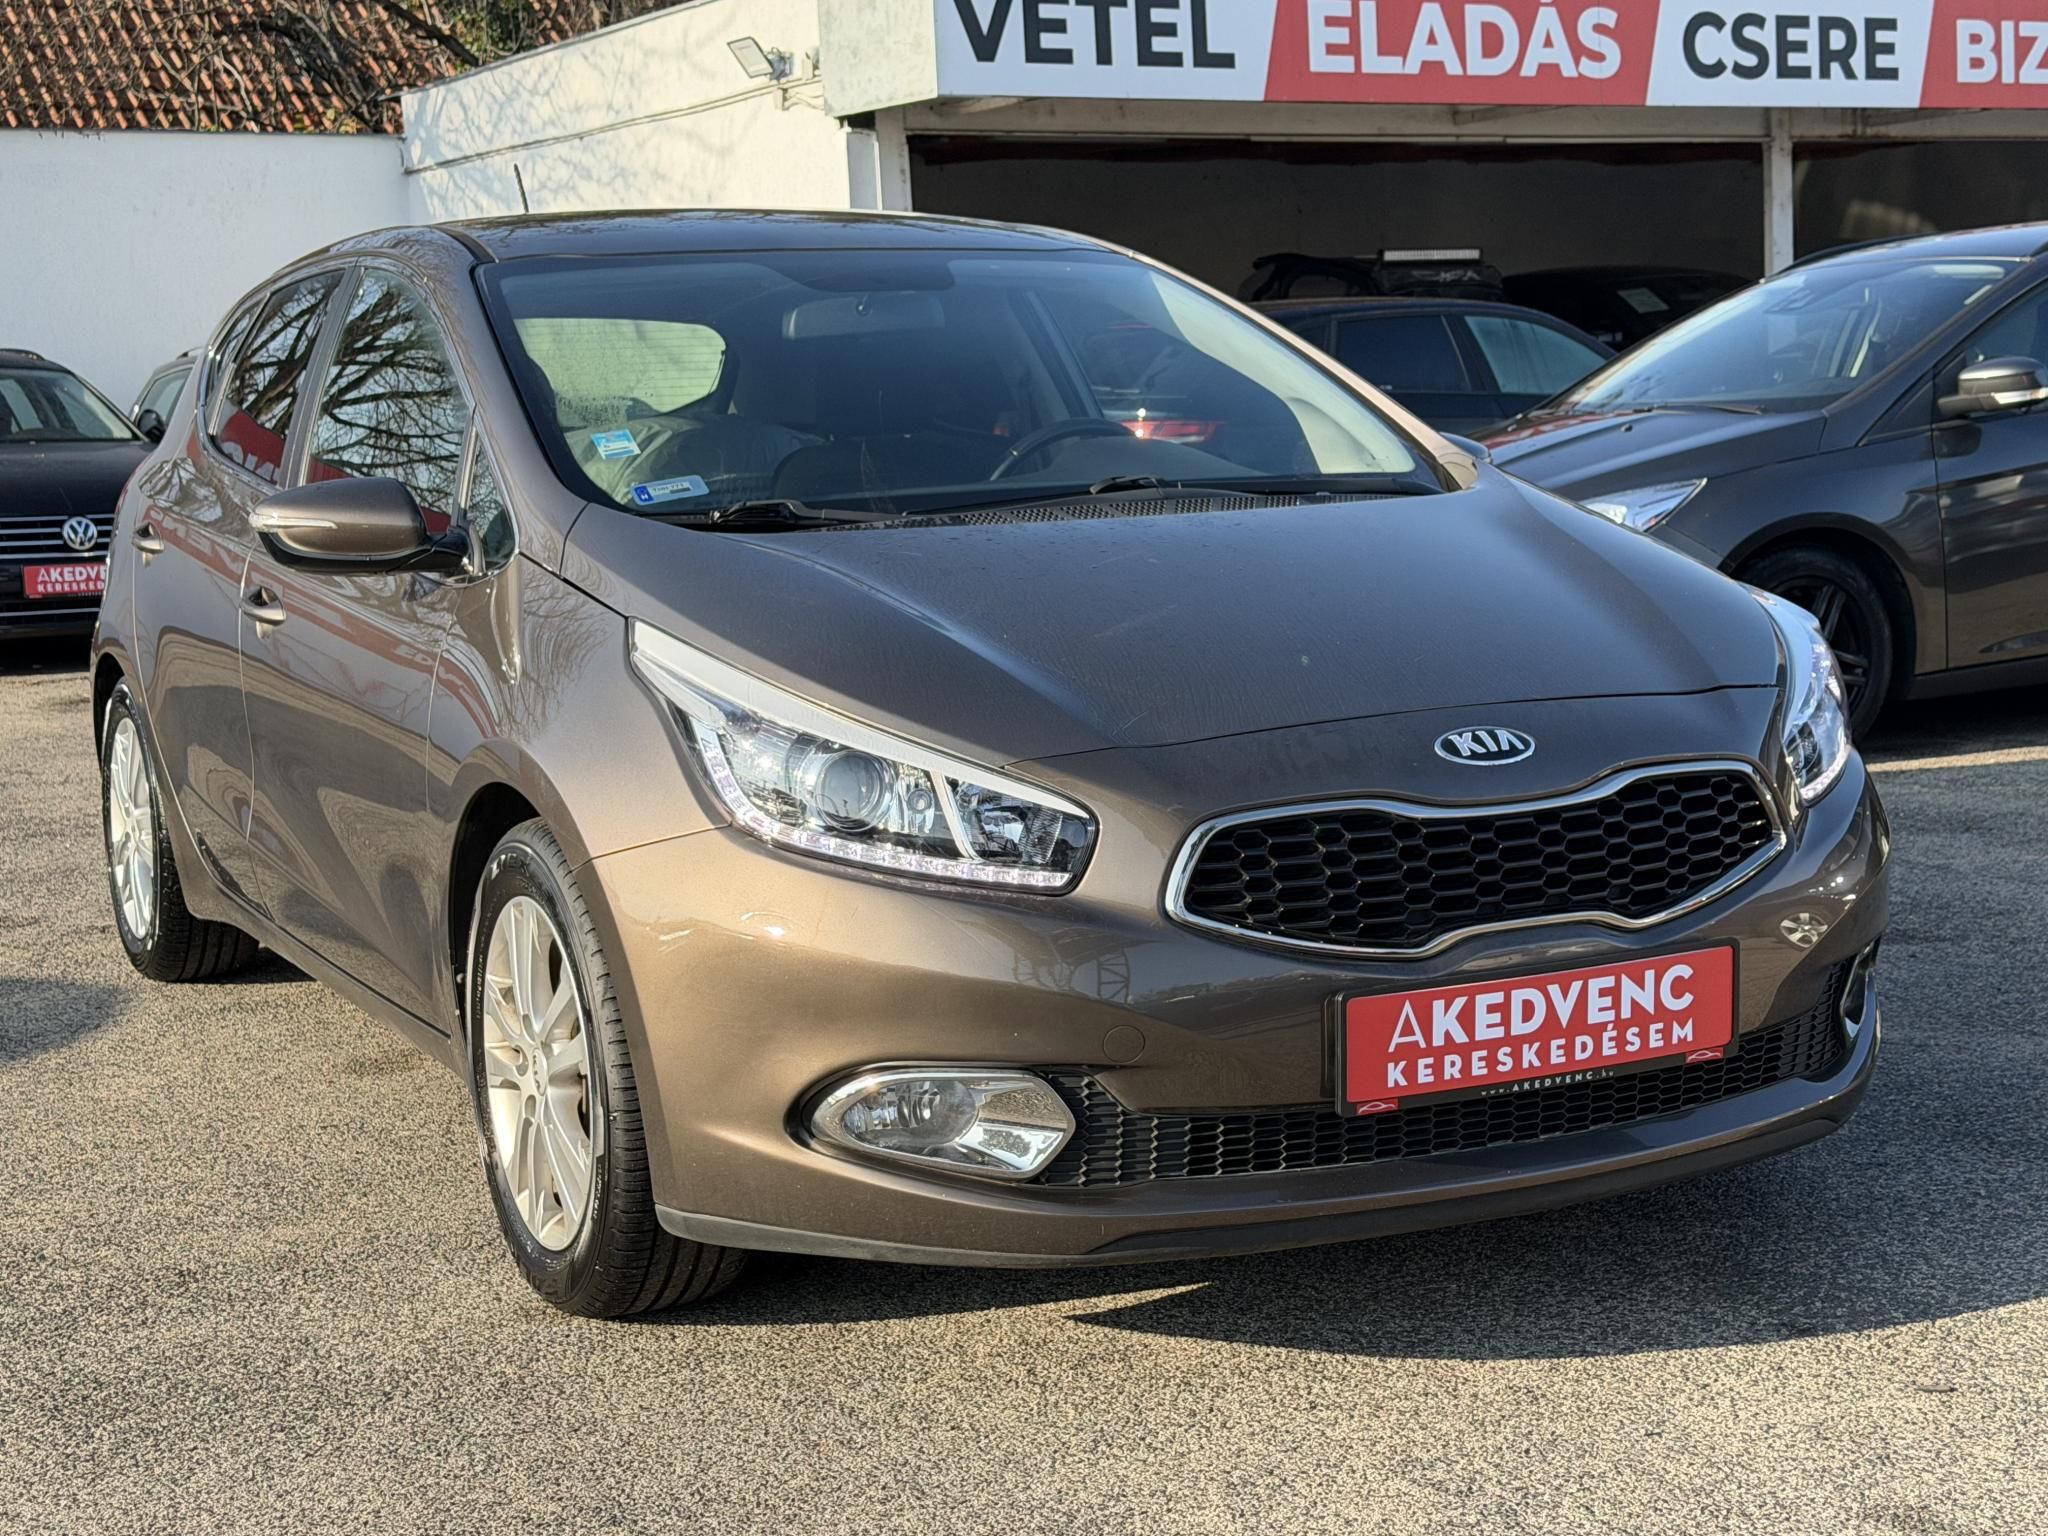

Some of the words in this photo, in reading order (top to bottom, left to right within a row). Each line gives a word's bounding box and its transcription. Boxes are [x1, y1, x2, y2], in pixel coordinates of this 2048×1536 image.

[1307, 0, 1622, 79] ELADÁS
[1683, 11, 1899, 81] CSERE
[1956, 19, 2048, 84] BIZ
[1447, 729, 1525, 757] KIA
[1387, 1018, 1694, 1088] KERESKEDÉSEM
